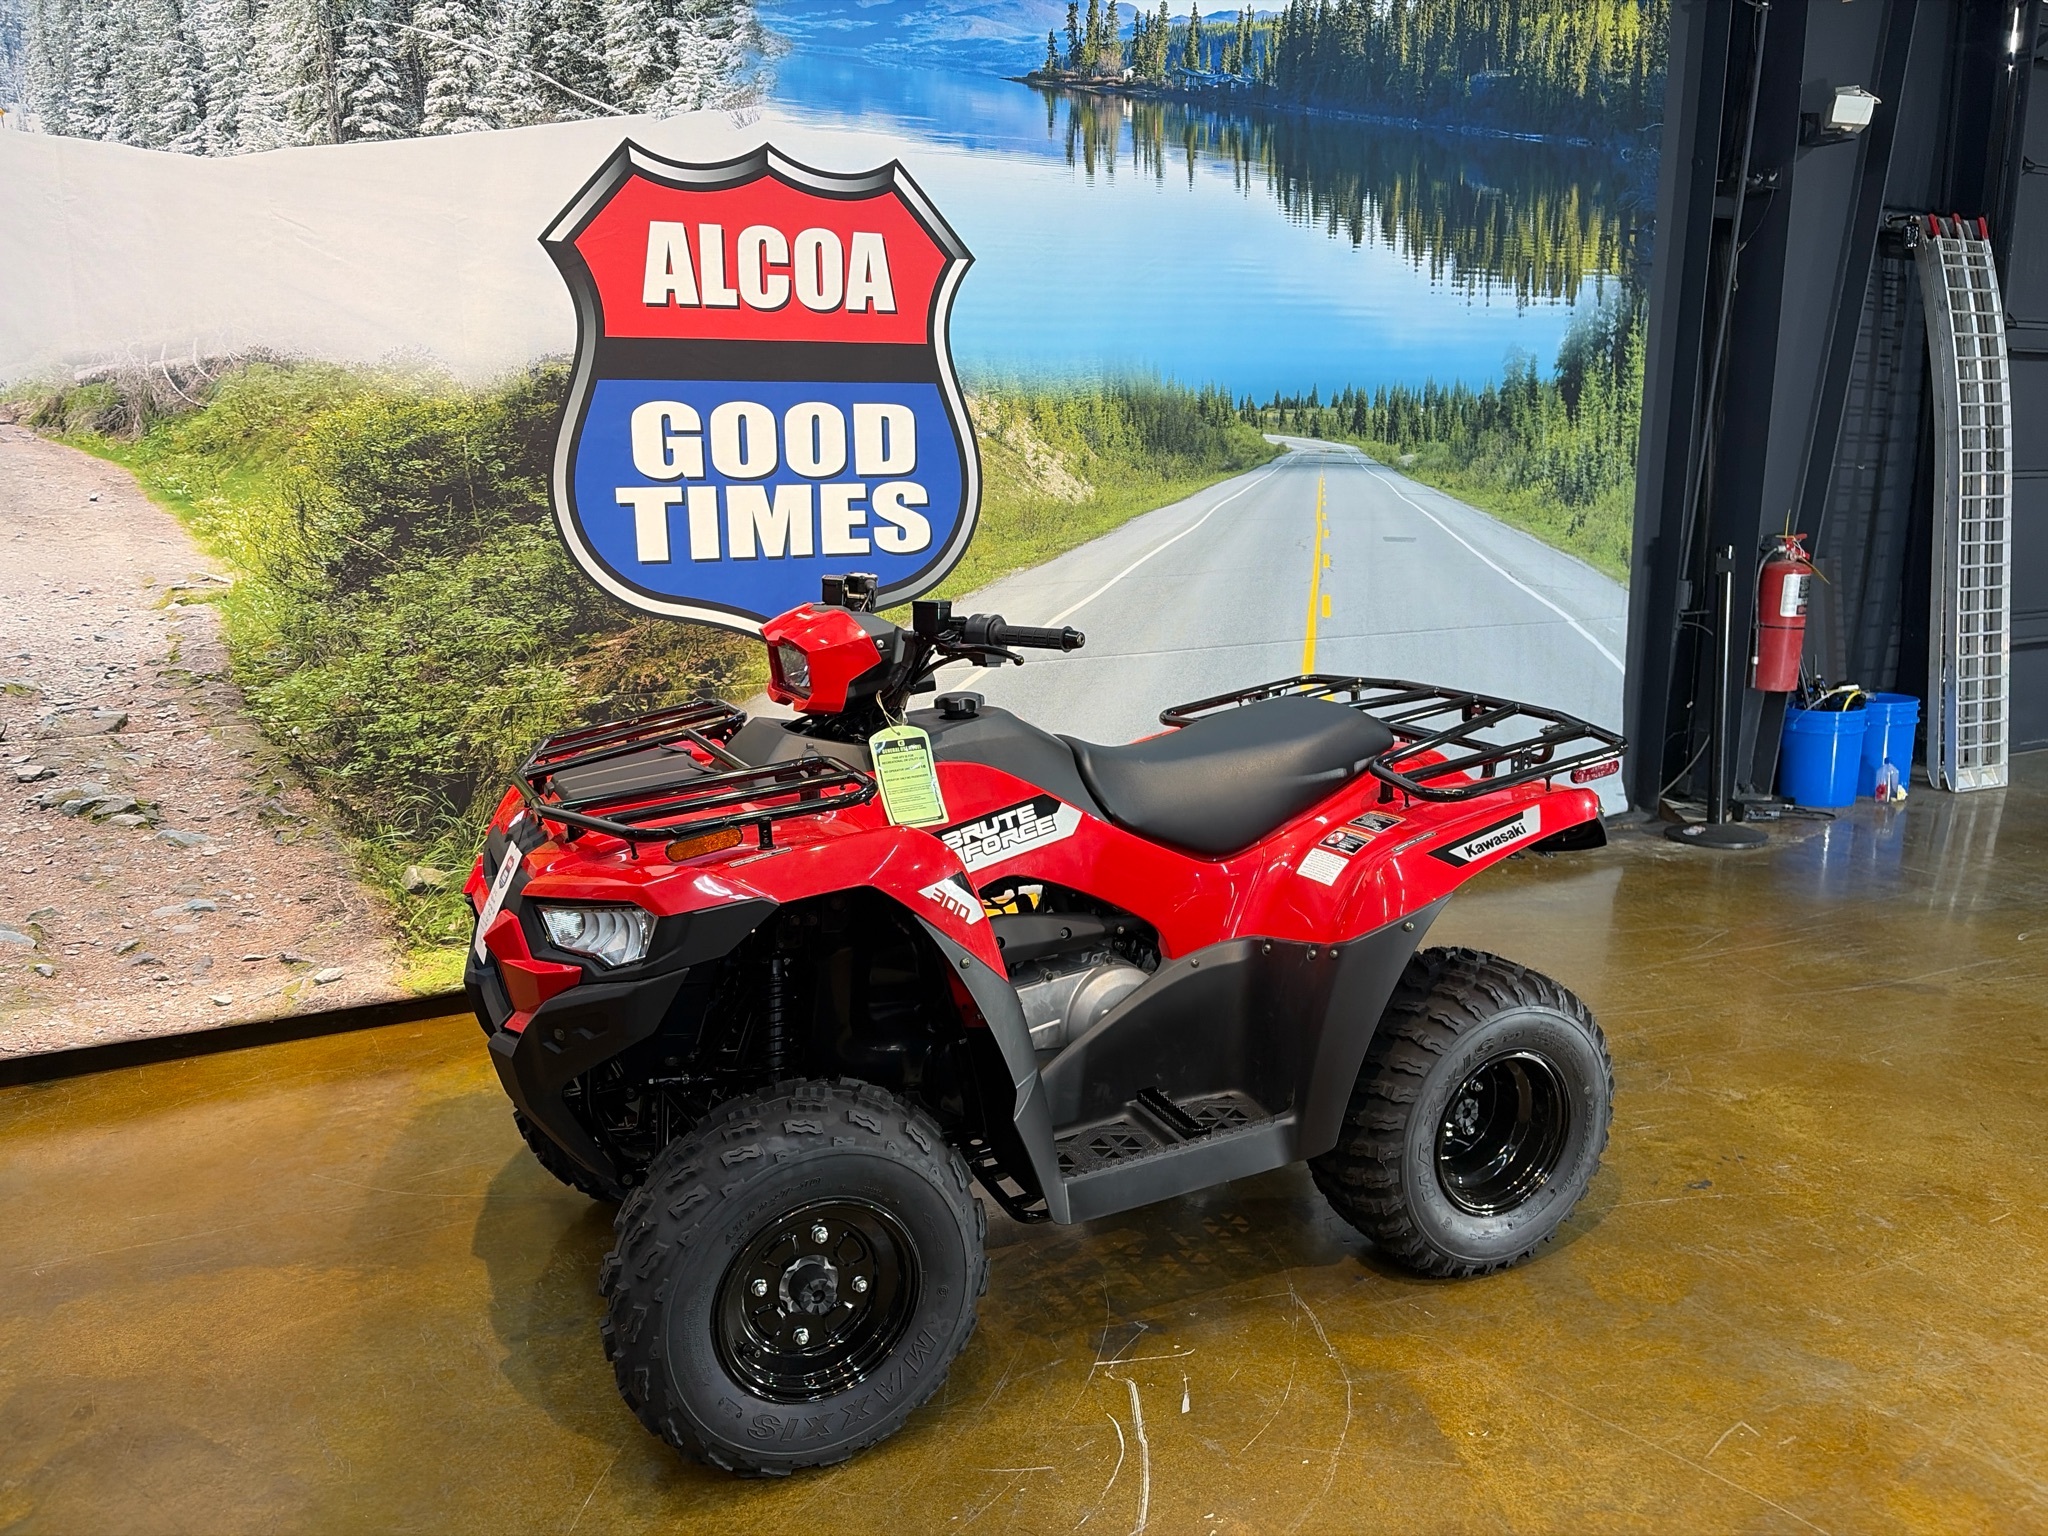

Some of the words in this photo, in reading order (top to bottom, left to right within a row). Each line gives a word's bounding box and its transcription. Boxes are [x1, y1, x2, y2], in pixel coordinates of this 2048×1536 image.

[642, 220, 898, 314] ALCOA
[630, 400, 917, 481] GOOD
[615, 481, 932, 563] TIMES
[942, 804, 1038, 850] BRUTE
[962, 814, 1057, 864] FORCE
[1464, 822, 1527, 858] Kawasaki
[930, 887, 971, 923] 300
[1418, 1037, 1495, 1203] MAXXIS
[746, 1328, 939, 1442] MAXXIS
